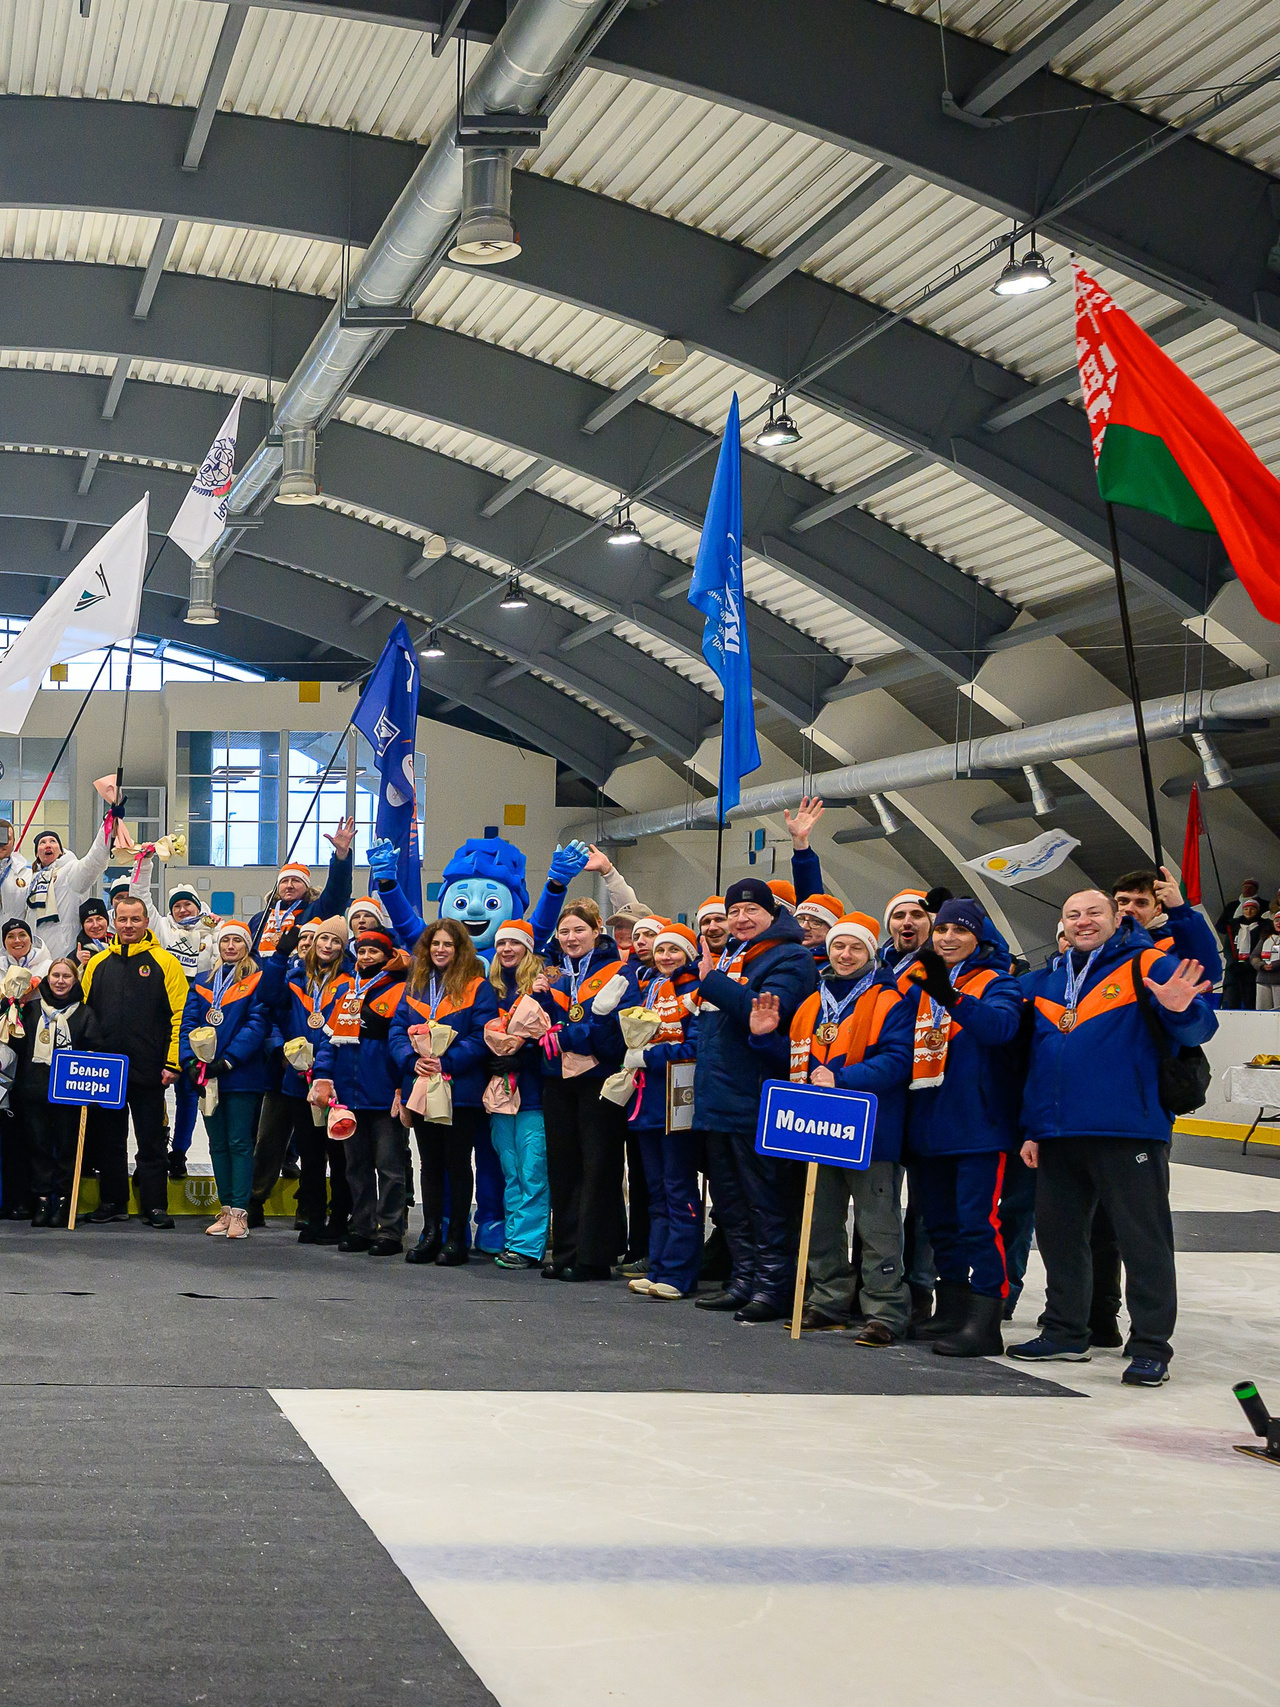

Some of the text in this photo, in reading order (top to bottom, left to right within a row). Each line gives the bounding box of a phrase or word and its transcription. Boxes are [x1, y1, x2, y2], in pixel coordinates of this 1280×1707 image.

[69, 1061, 110, 1078] Белые
[65, 1080, 111, 1096] тигры
[775, 1109, 856, 1141] Молния
